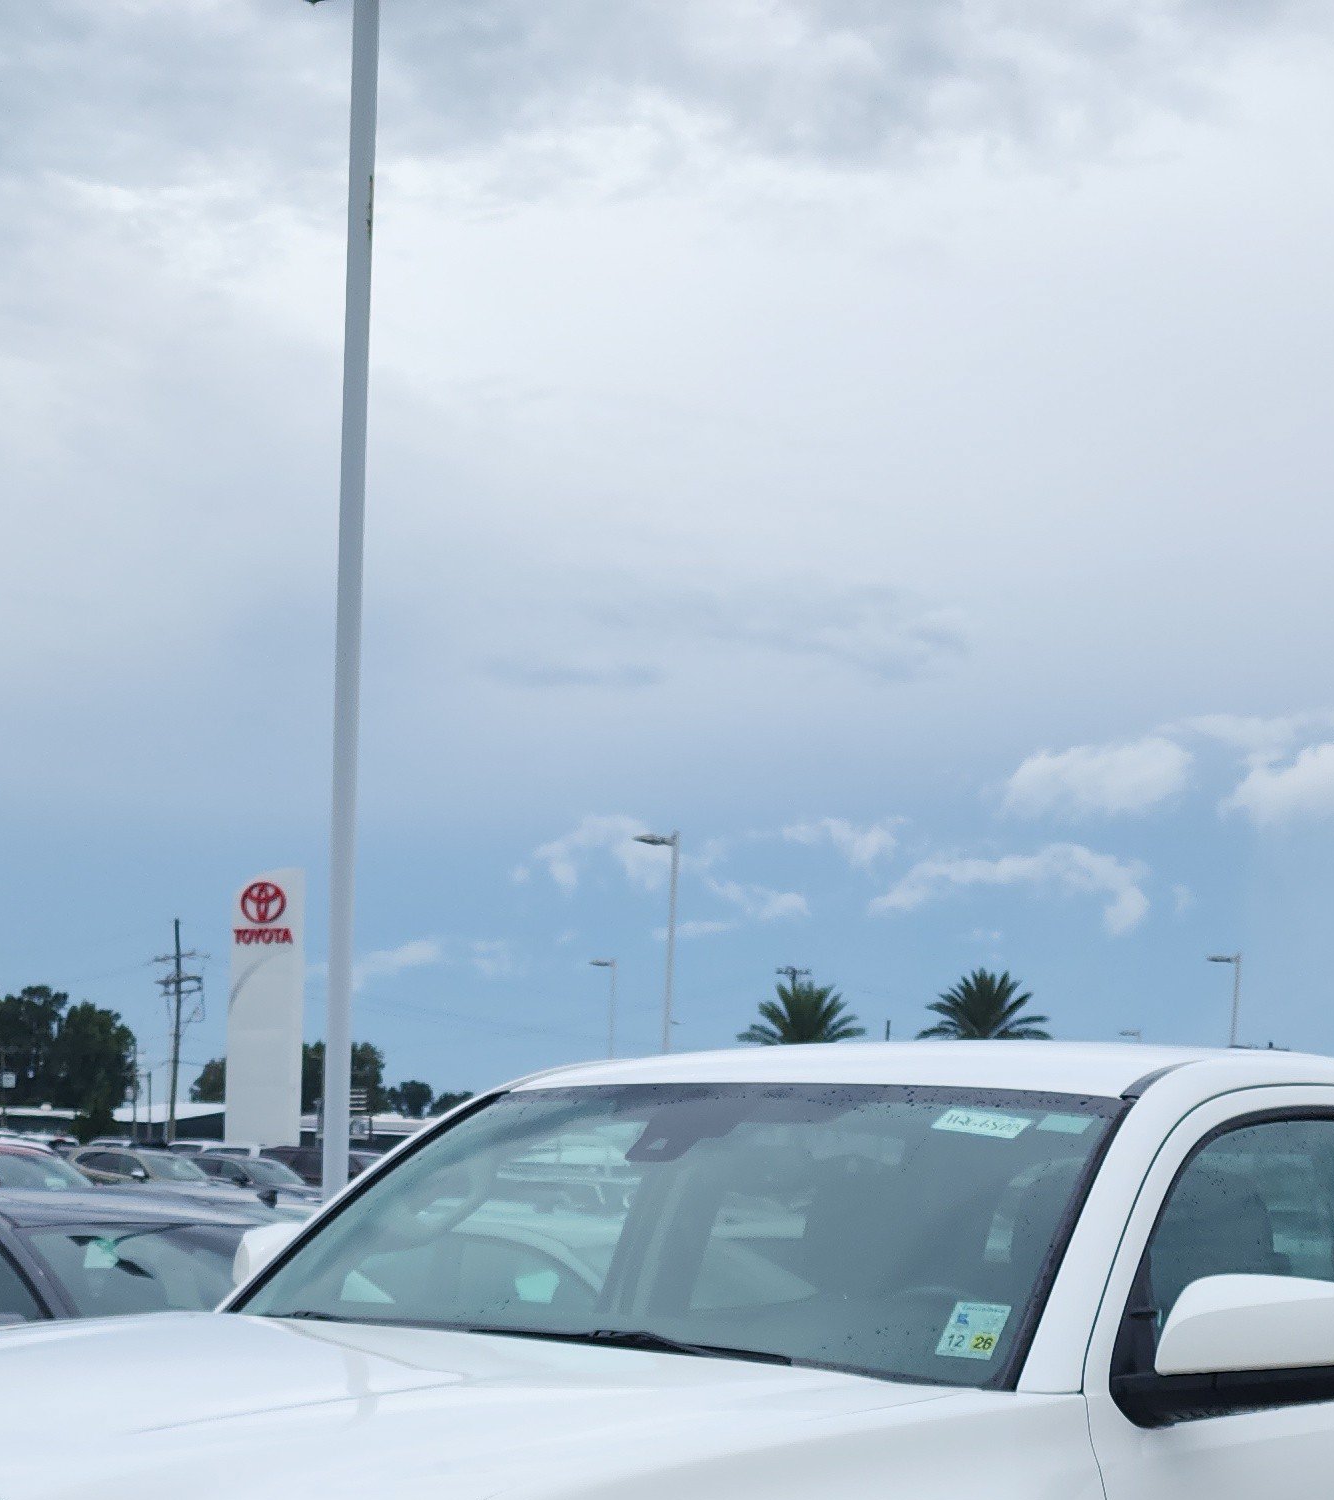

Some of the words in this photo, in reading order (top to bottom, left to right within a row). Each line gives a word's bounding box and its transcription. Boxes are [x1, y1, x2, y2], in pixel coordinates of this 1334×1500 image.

[233, 928, 293, 944] TOYOTA
[948, 1334, 965, 1348] 12
[973, 1336, 994, 1350] 26
